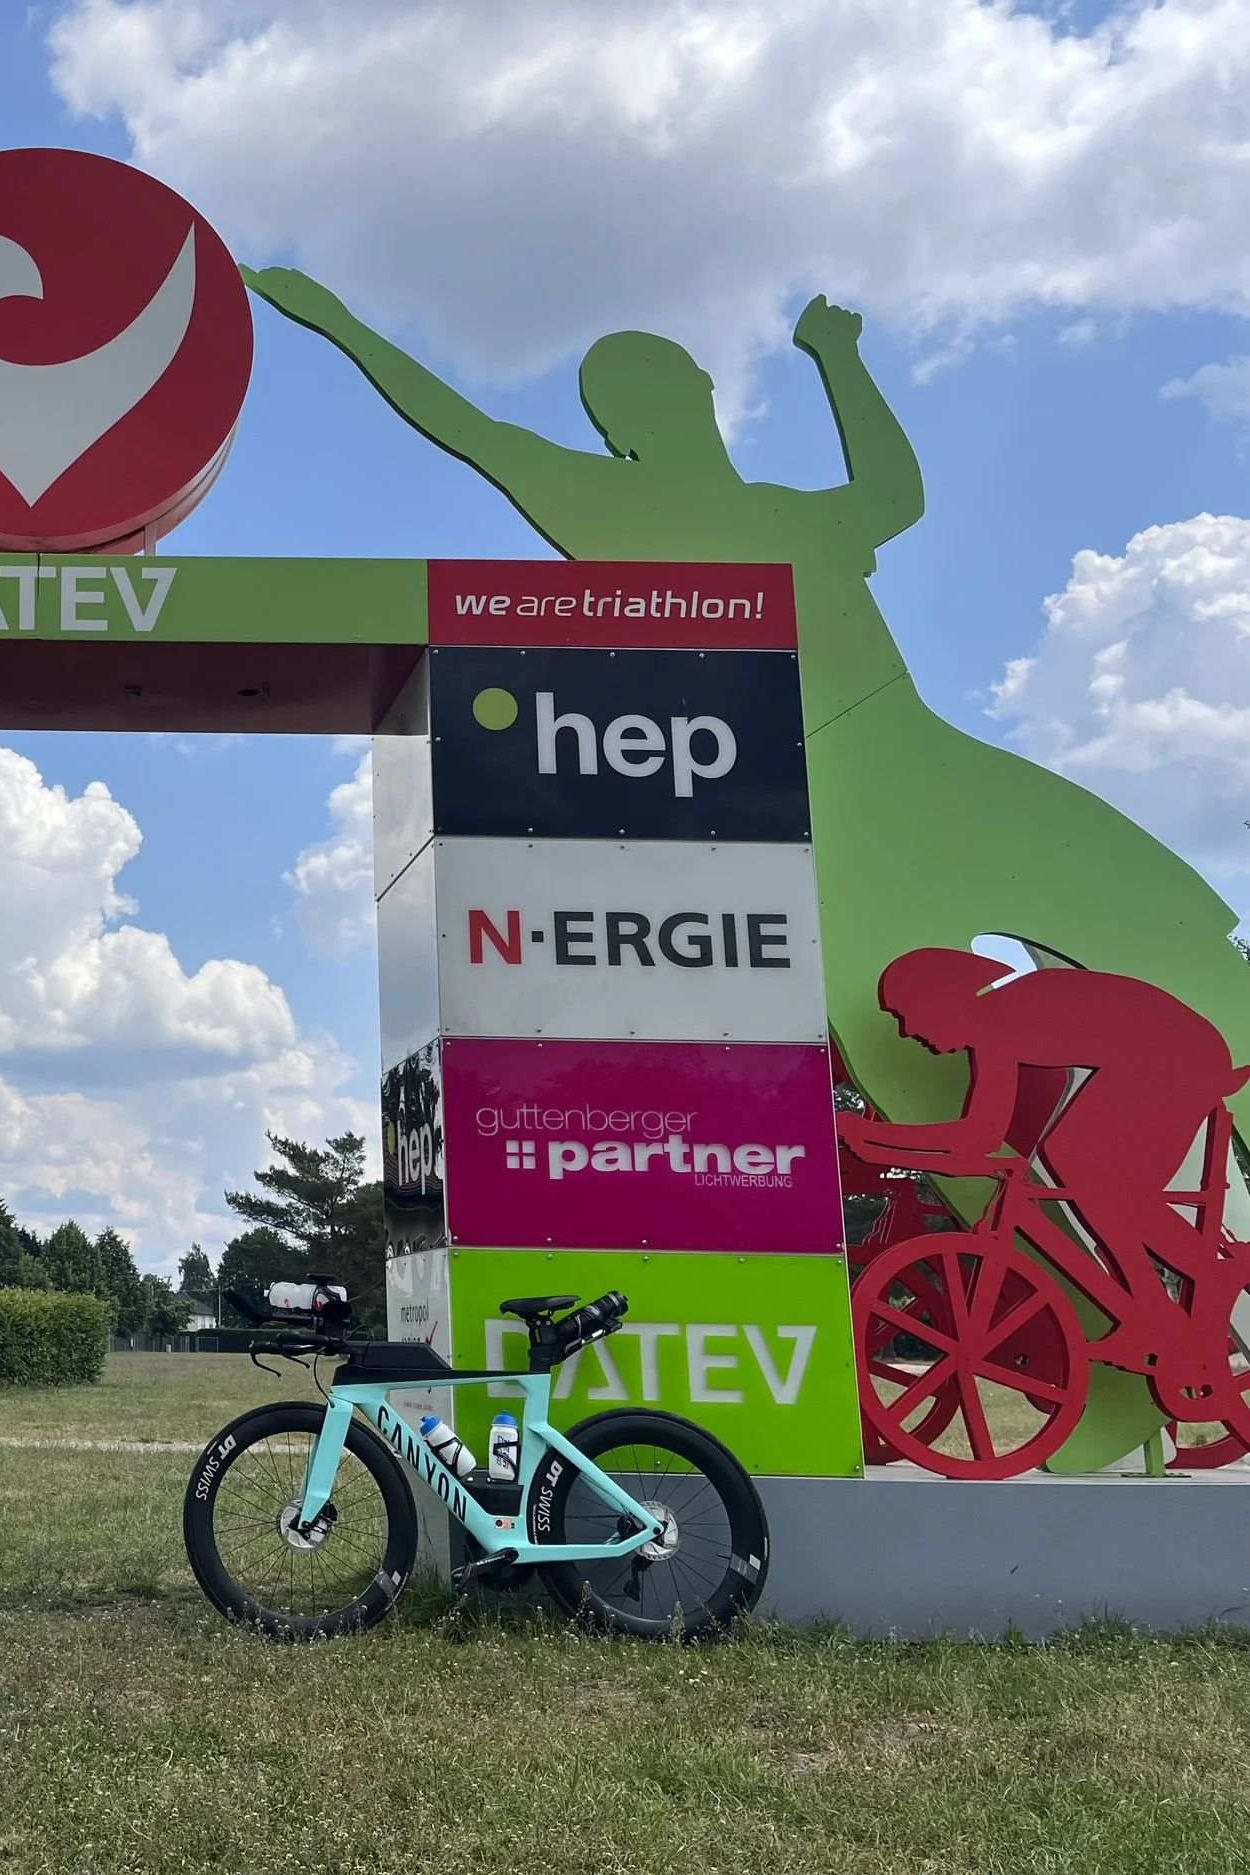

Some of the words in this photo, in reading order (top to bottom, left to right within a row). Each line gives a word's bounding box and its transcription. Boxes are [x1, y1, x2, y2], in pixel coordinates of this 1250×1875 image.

[455, 595, 511, 616] we
[516, 596, 577, 617] are
[582, 589, 764, 619] triathlon!
[535, 691, 738, 798] hep
[475, 1103, 699, 1139] guttenberger
[396, 1118, 433, 1196] hep
[548, 1134, 806, 1180] partner
[694, 1173, 793, 1188] LICHTWERBUNG
[400, 1298, 430, 1327] metropol
[217, 1433, 237, 1460] DT
[376, 1405, 467, 1523] CANYON
[195, 1455, 220, 1501] SWISS
[545, 1460, 564, 1488] DT
[537, 1485, 554, 1532] SWISS
